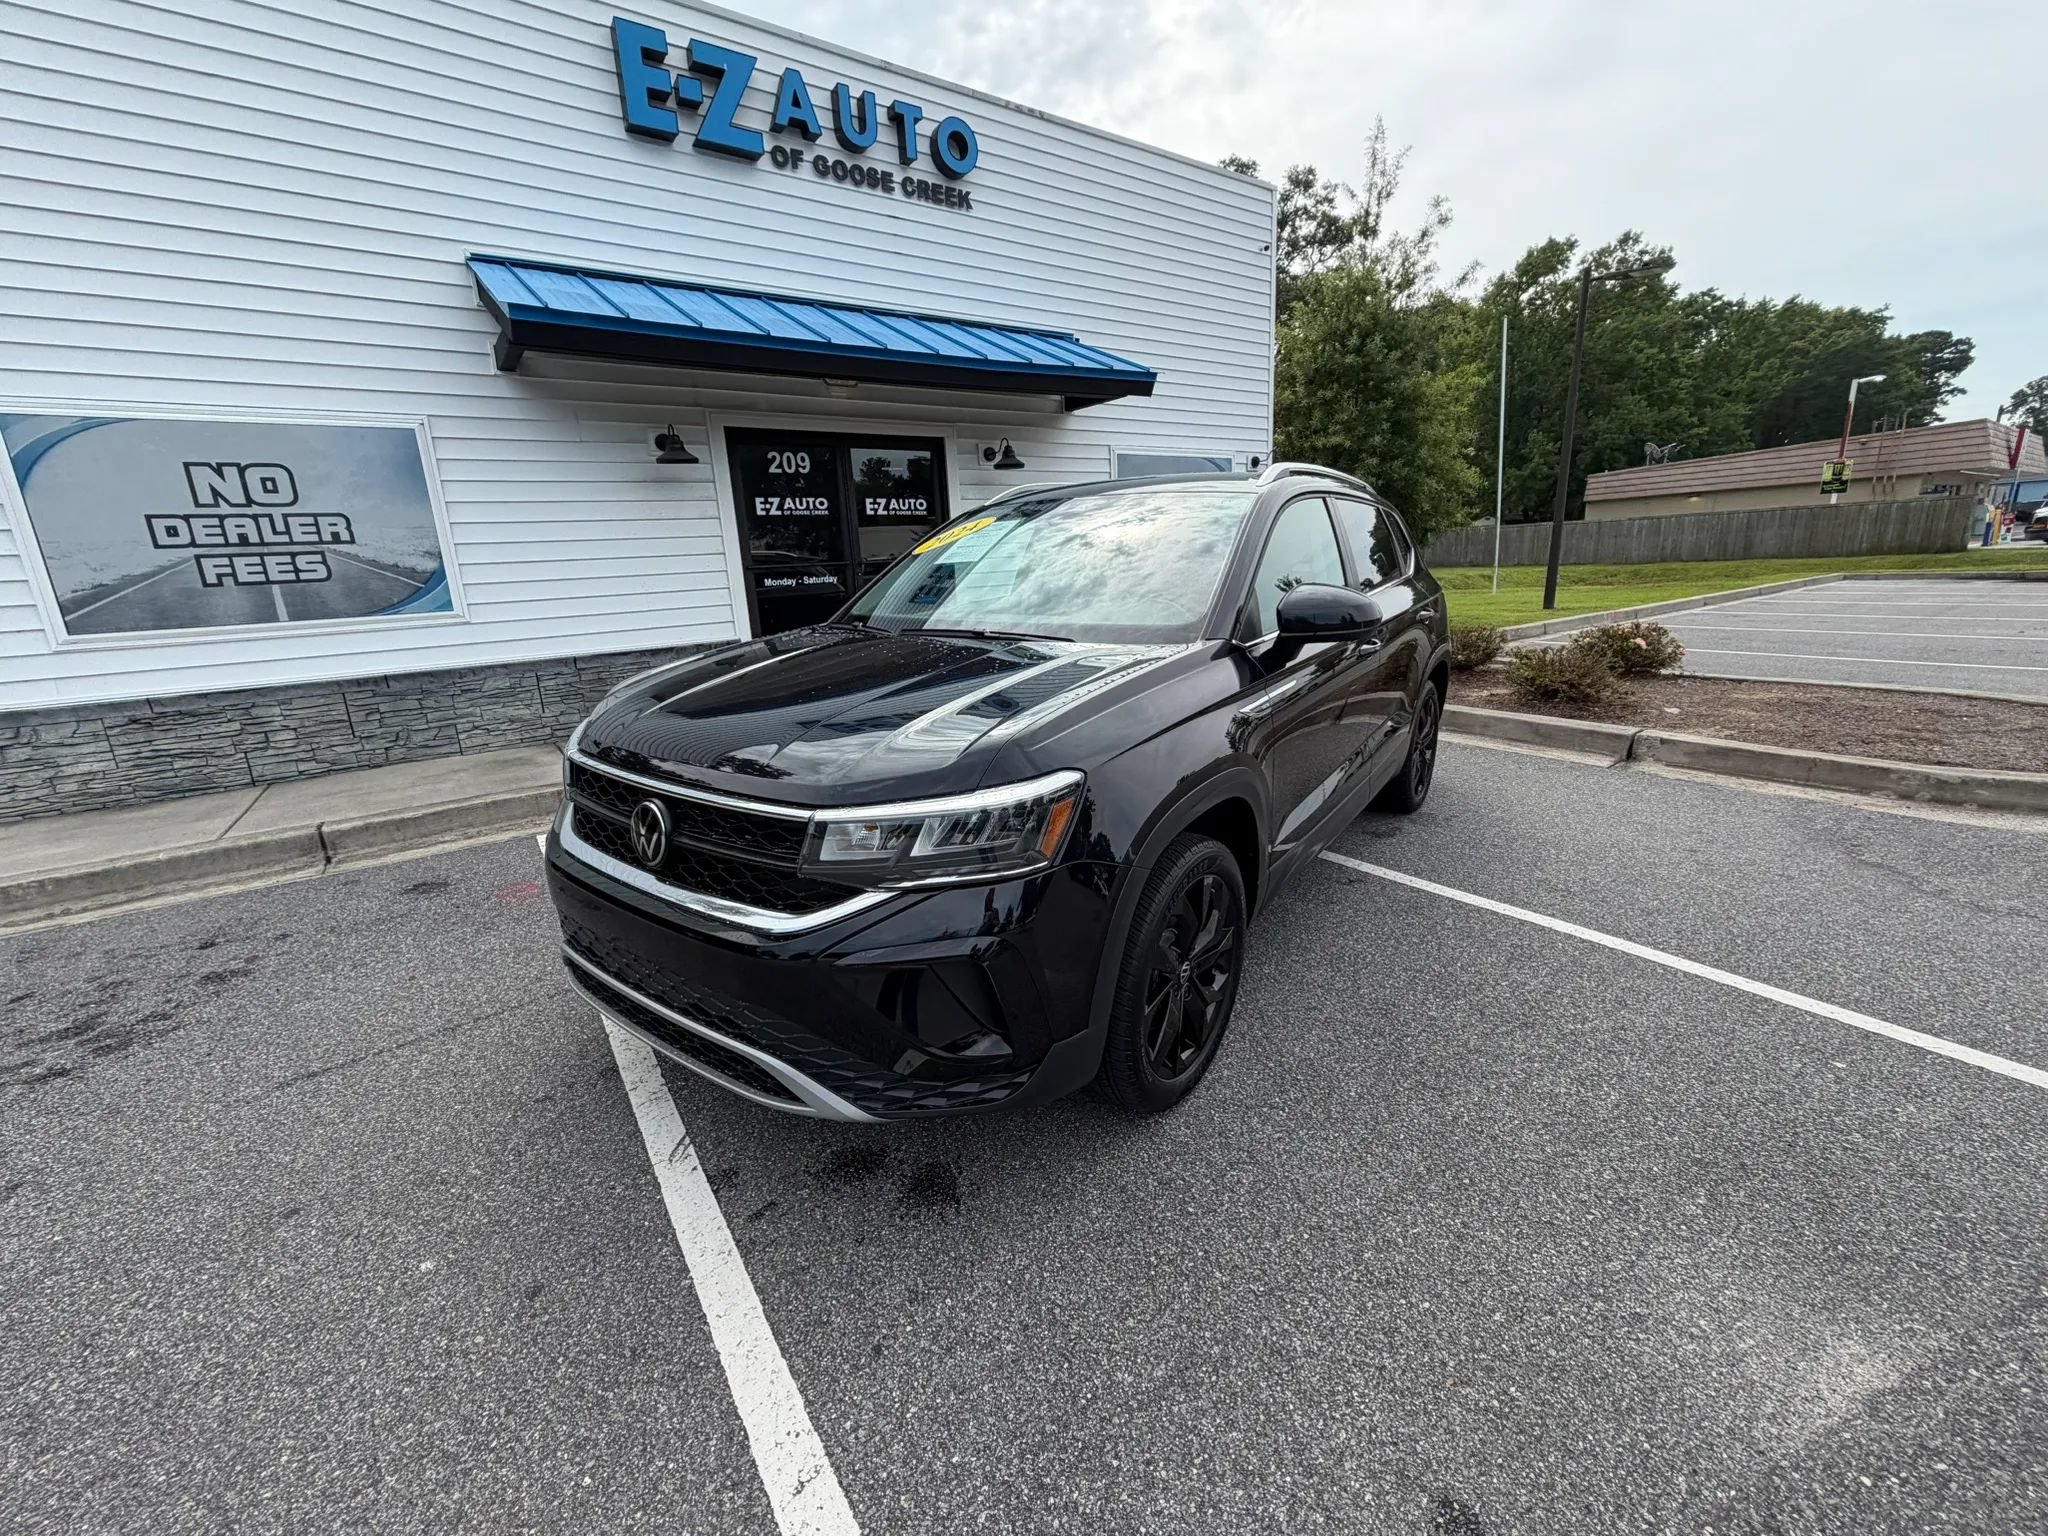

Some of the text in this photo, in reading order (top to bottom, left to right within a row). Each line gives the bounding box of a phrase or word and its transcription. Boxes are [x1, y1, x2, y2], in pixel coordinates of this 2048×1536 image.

[611, 16, 978, 180] E-Z AUTO
[771, 145, 974, 211] OF GOOSE CREEK
[767, 451, 811, 474] 209
[182, 461, 299, 508] NO
[754, 497, 828, 515] E-Z AUTO
[865, 498, 927, 515] E-Z AUTO
[144, 512, 356, 549] DEALER
[194, 551, 332, 587] FEES
[764, 577, 797, 587] Monday
[803, 576, 838, 585] Saturday
